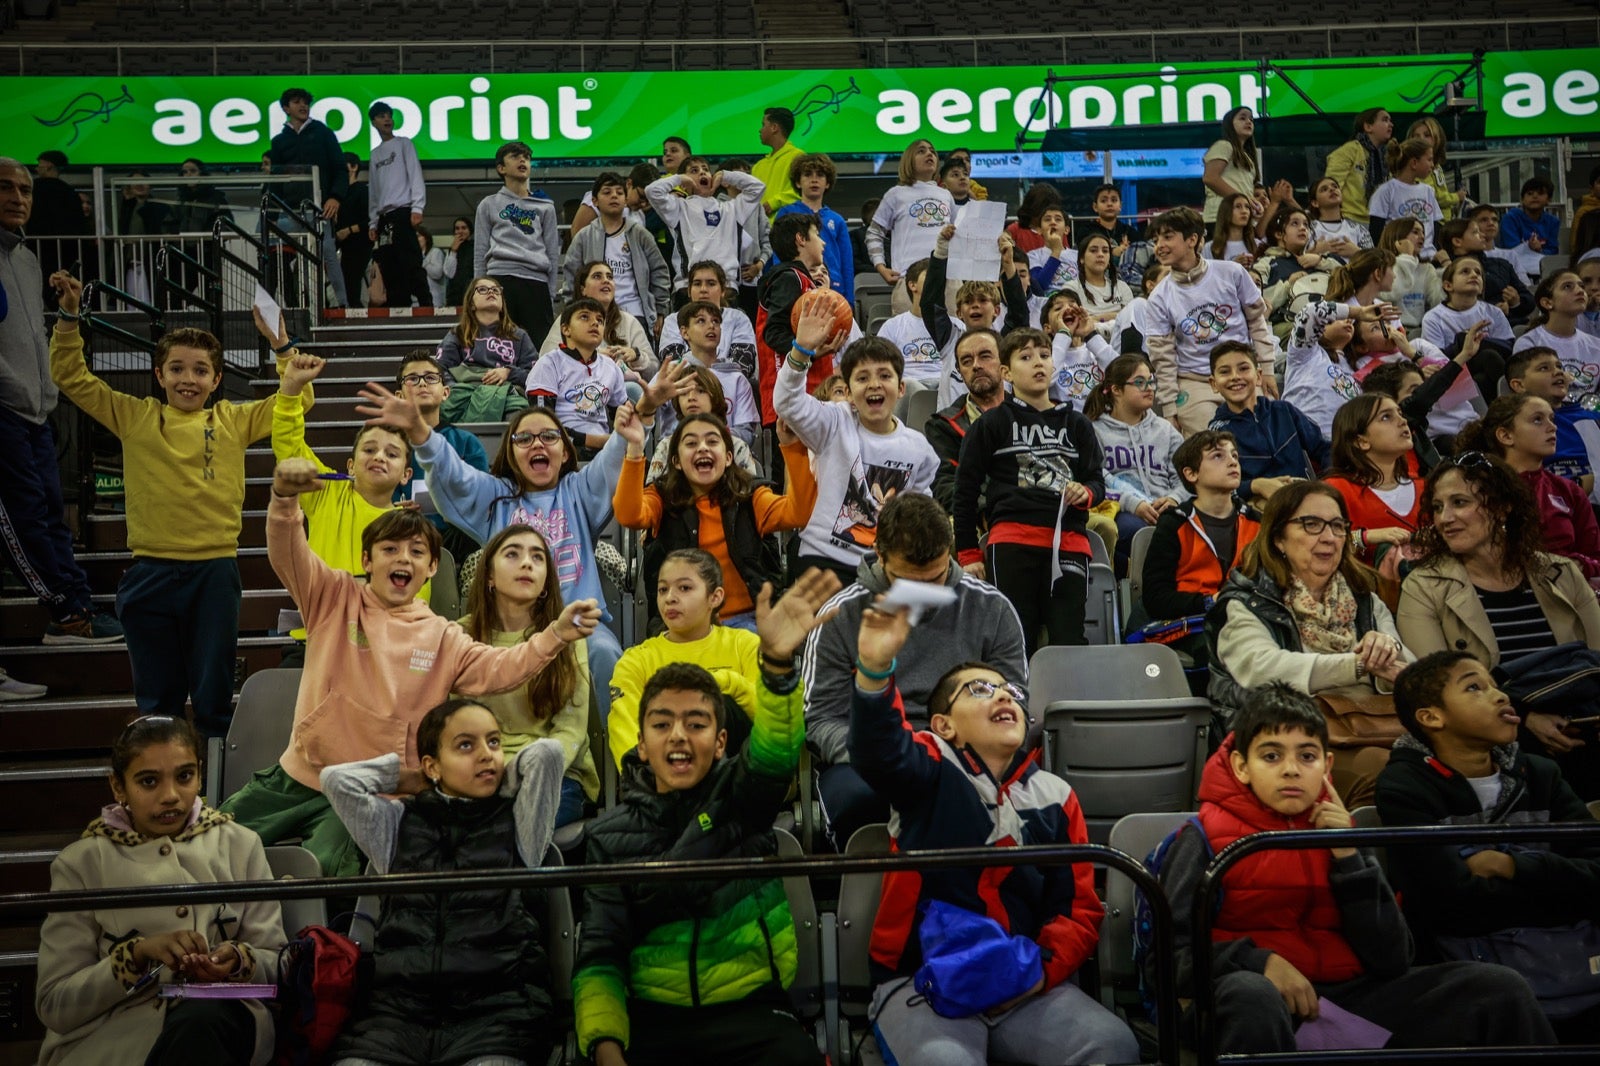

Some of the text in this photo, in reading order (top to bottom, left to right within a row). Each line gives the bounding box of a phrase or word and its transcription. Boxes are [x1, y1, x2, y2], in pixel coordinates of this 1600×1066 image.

[875, 65, 1271, 135] aeroprint
[1500, 70, 1599, 118] ae
[1012, 421, 1074, 448] NASA
[95, 476, 125, 489] ALID
